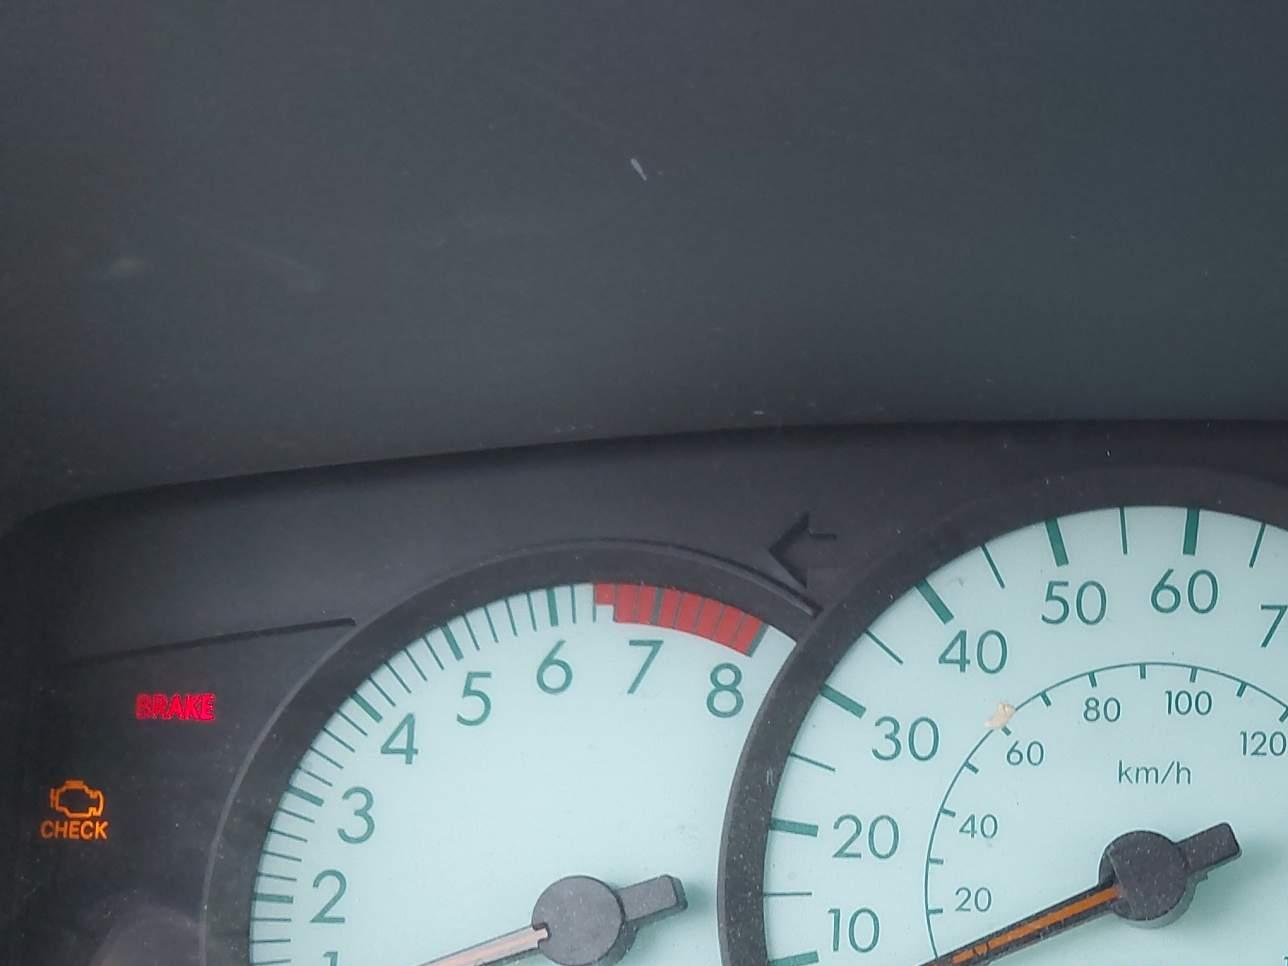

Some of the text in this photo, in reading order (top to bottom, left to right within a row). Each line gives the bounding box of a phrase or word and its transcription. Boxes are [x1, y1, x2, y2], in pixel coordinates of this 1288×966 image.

[1041, 580, 1107, 625] 50
[1151, 569, 1218, 614] 60
[536, 640, 573, 693] 6
[628, 640, 663, 694] 7
[938, 630, 1008, 674] 40
[136, 694, 215, 720] BRAKE
[457, 672, 492, 726] 5
[706, 663, 744, 718] 8
[1083, 697, 1121, 722] 80
[1165, 690, 1213, 716] 100
[380, 714, 419, 764] 4
[872, 716, 939, 761] 30
[1006, 741, 1044, 766] 60
[1240, 731, 1287, 757] 120
[1118, 761, 1192, 785] km/h
[41, 821, 108, 839] CHECK
[338, 787, 375, 844] 3
[833, 814, 899, 859] 20
[959, 814, 998, 839] 40
[311, 869, 347, 924] 2
[955, 887, 991, 912] 20
[828, 908, 880, 952] 10
